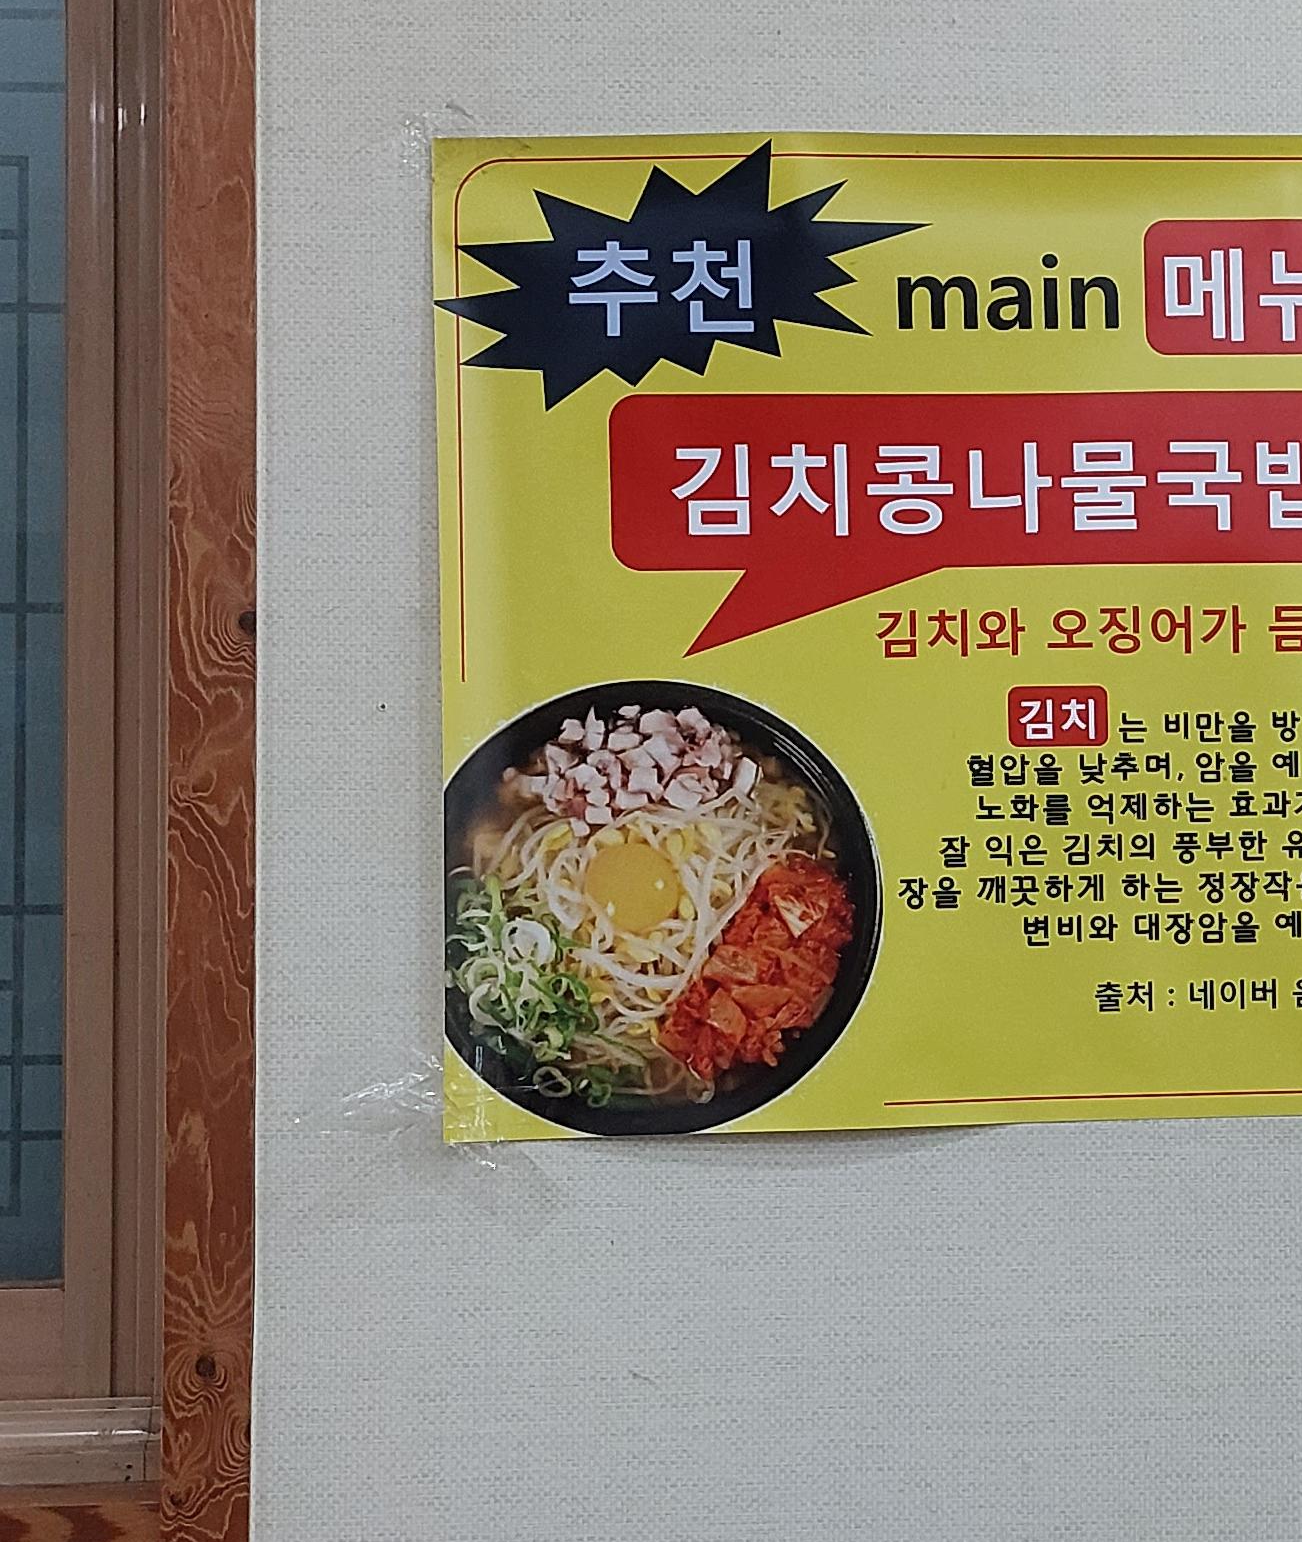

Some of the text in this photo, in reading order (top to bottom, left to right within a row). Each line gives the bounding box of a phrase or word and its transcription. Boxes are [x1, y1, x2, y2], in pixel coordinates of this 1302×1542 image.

[568, 239, 755, 337] 추천
[896, 253, 1120, 331] main
[876, 608, 1026, 659] 김치와
[1046, 607, 1246, 655] 오징어가
[1164, 711, 1257, 743] 비만을
[966, 753, 1063, 787] 혈압을
[975, 793, 1072, 826] 노화를
[1087, 792, 1215, 825] 억제하는
[938, 835, 971, 869] 잘
[985, 834, 1048, 867] 익은
[1062, 832, 1155, 866] 김치의
[1172, 830, 1268, 865] 풍부한
[898, 876, 962, 910] 장을
[976, 873, 1105, 907] 깨끗하게
[1121, 872, 1183, 904] 하는
[1023, 913, 1119, 947] 변비와
[1134, 911, 1260, 945] 대장암을
[1094, 980, 1153, 1013] 출처
[1189, 978, 1277, 1011] 네이버
